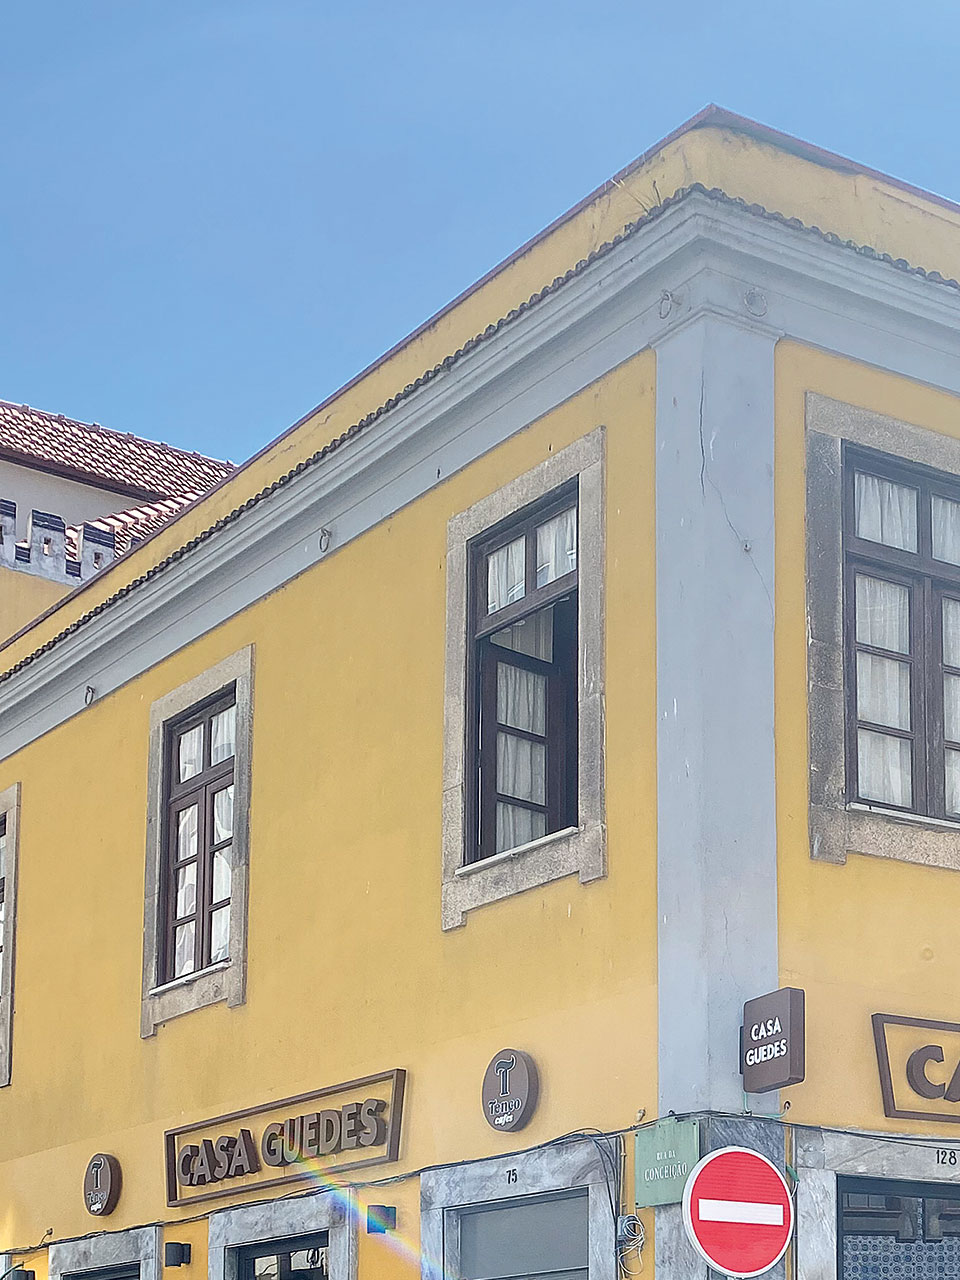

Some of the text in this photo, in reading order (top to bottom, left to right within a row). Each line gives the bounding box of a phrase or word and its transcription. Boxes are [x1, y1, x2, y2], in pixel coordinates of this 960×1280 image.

[751, 1016, 782, 1041] CASA
[745, 1038, 787, 1066] GUEDES
[177, 1099, 388, 1186] CASA GUEDES
[936, 1149, 957, 1165] 128
[506, 1168, 518, 1184] 75
[644, 1160, 687, 1181] CONCEIÇÃO
